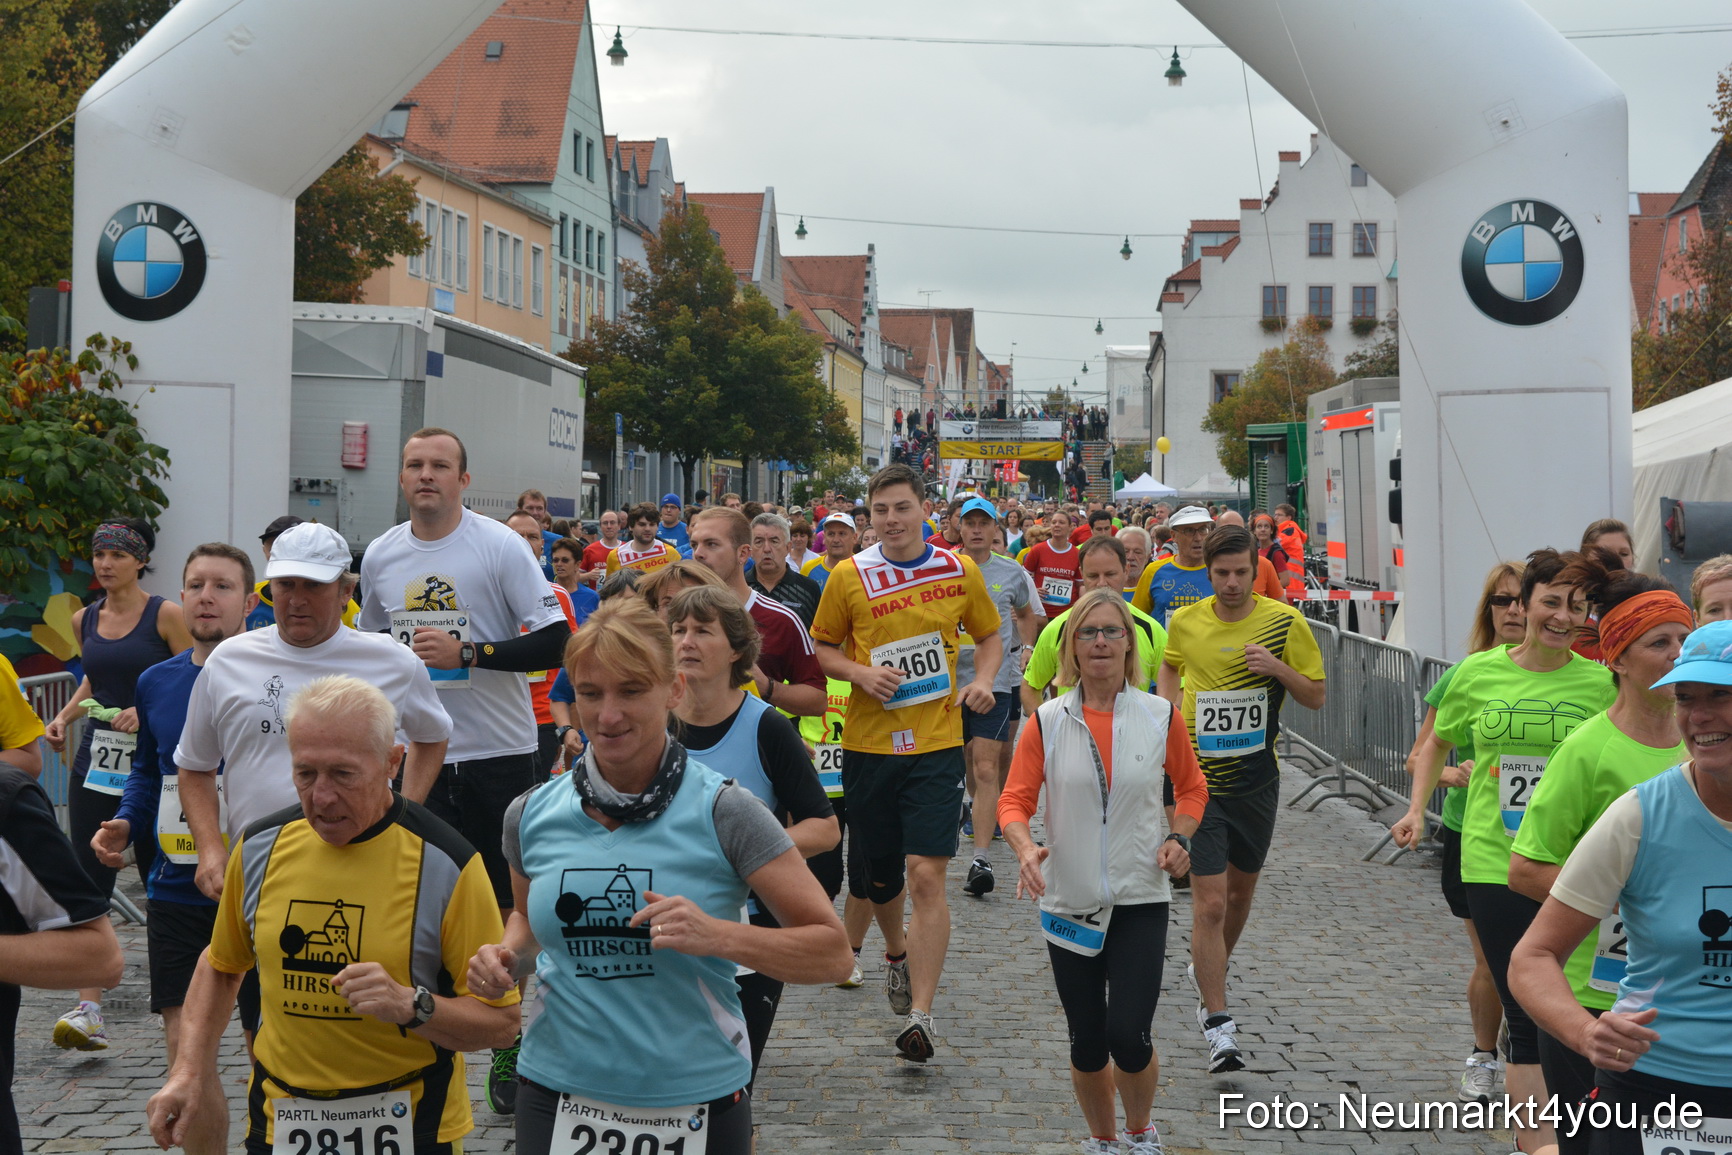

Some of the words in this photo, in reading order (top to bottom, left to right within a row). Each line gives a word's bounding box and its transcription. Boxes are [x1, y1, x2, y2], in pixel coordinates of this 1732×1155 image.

[104, 204, 198, 245] BMW
[1471, 202, 1576, 245] BMW
[549, 407, 578, 451] BOCK
[980, 445, 1023, 455] START
[1040, 567, 1071, 575] NEUMARKT
[1044, 583, 1070, 597] 2167
[871, 595, 916, 620] MAX
[920, 584, 967, 604] BÖGL
[393, 619, 415, 627] PARTL
[417, 618, 455, 627] Neumarkt
[896, 640, 930, 653] Neumarkt
[894, 680, 938, 699] Christoph
[1197, 697, 1220, 705] PARTL
[1221, 695, 1256, 705] Neumarkt
[1203, 704, 1262, 732] 2579
[94, 735, 113, 744] PARTL
[1216, 736, 1250, 749] Florian
[820, 748, 843, 770] 26
[1502, 763, 1534, 772] PARTL
[1050, 919, 1077, 940] Karin
[565, 940, 653, 957] HIRSCH
[1702, 952, 1732, 967] HI
[277, 1109, 318, 1121] PARTL
[321, 1107, 386, 1121] Neumarkt
[561, 1101, 609, 1121] PARTL
[612, 1111, 682, 1129] Neumarkt
[288, 1124, 401, 1155] 2816
